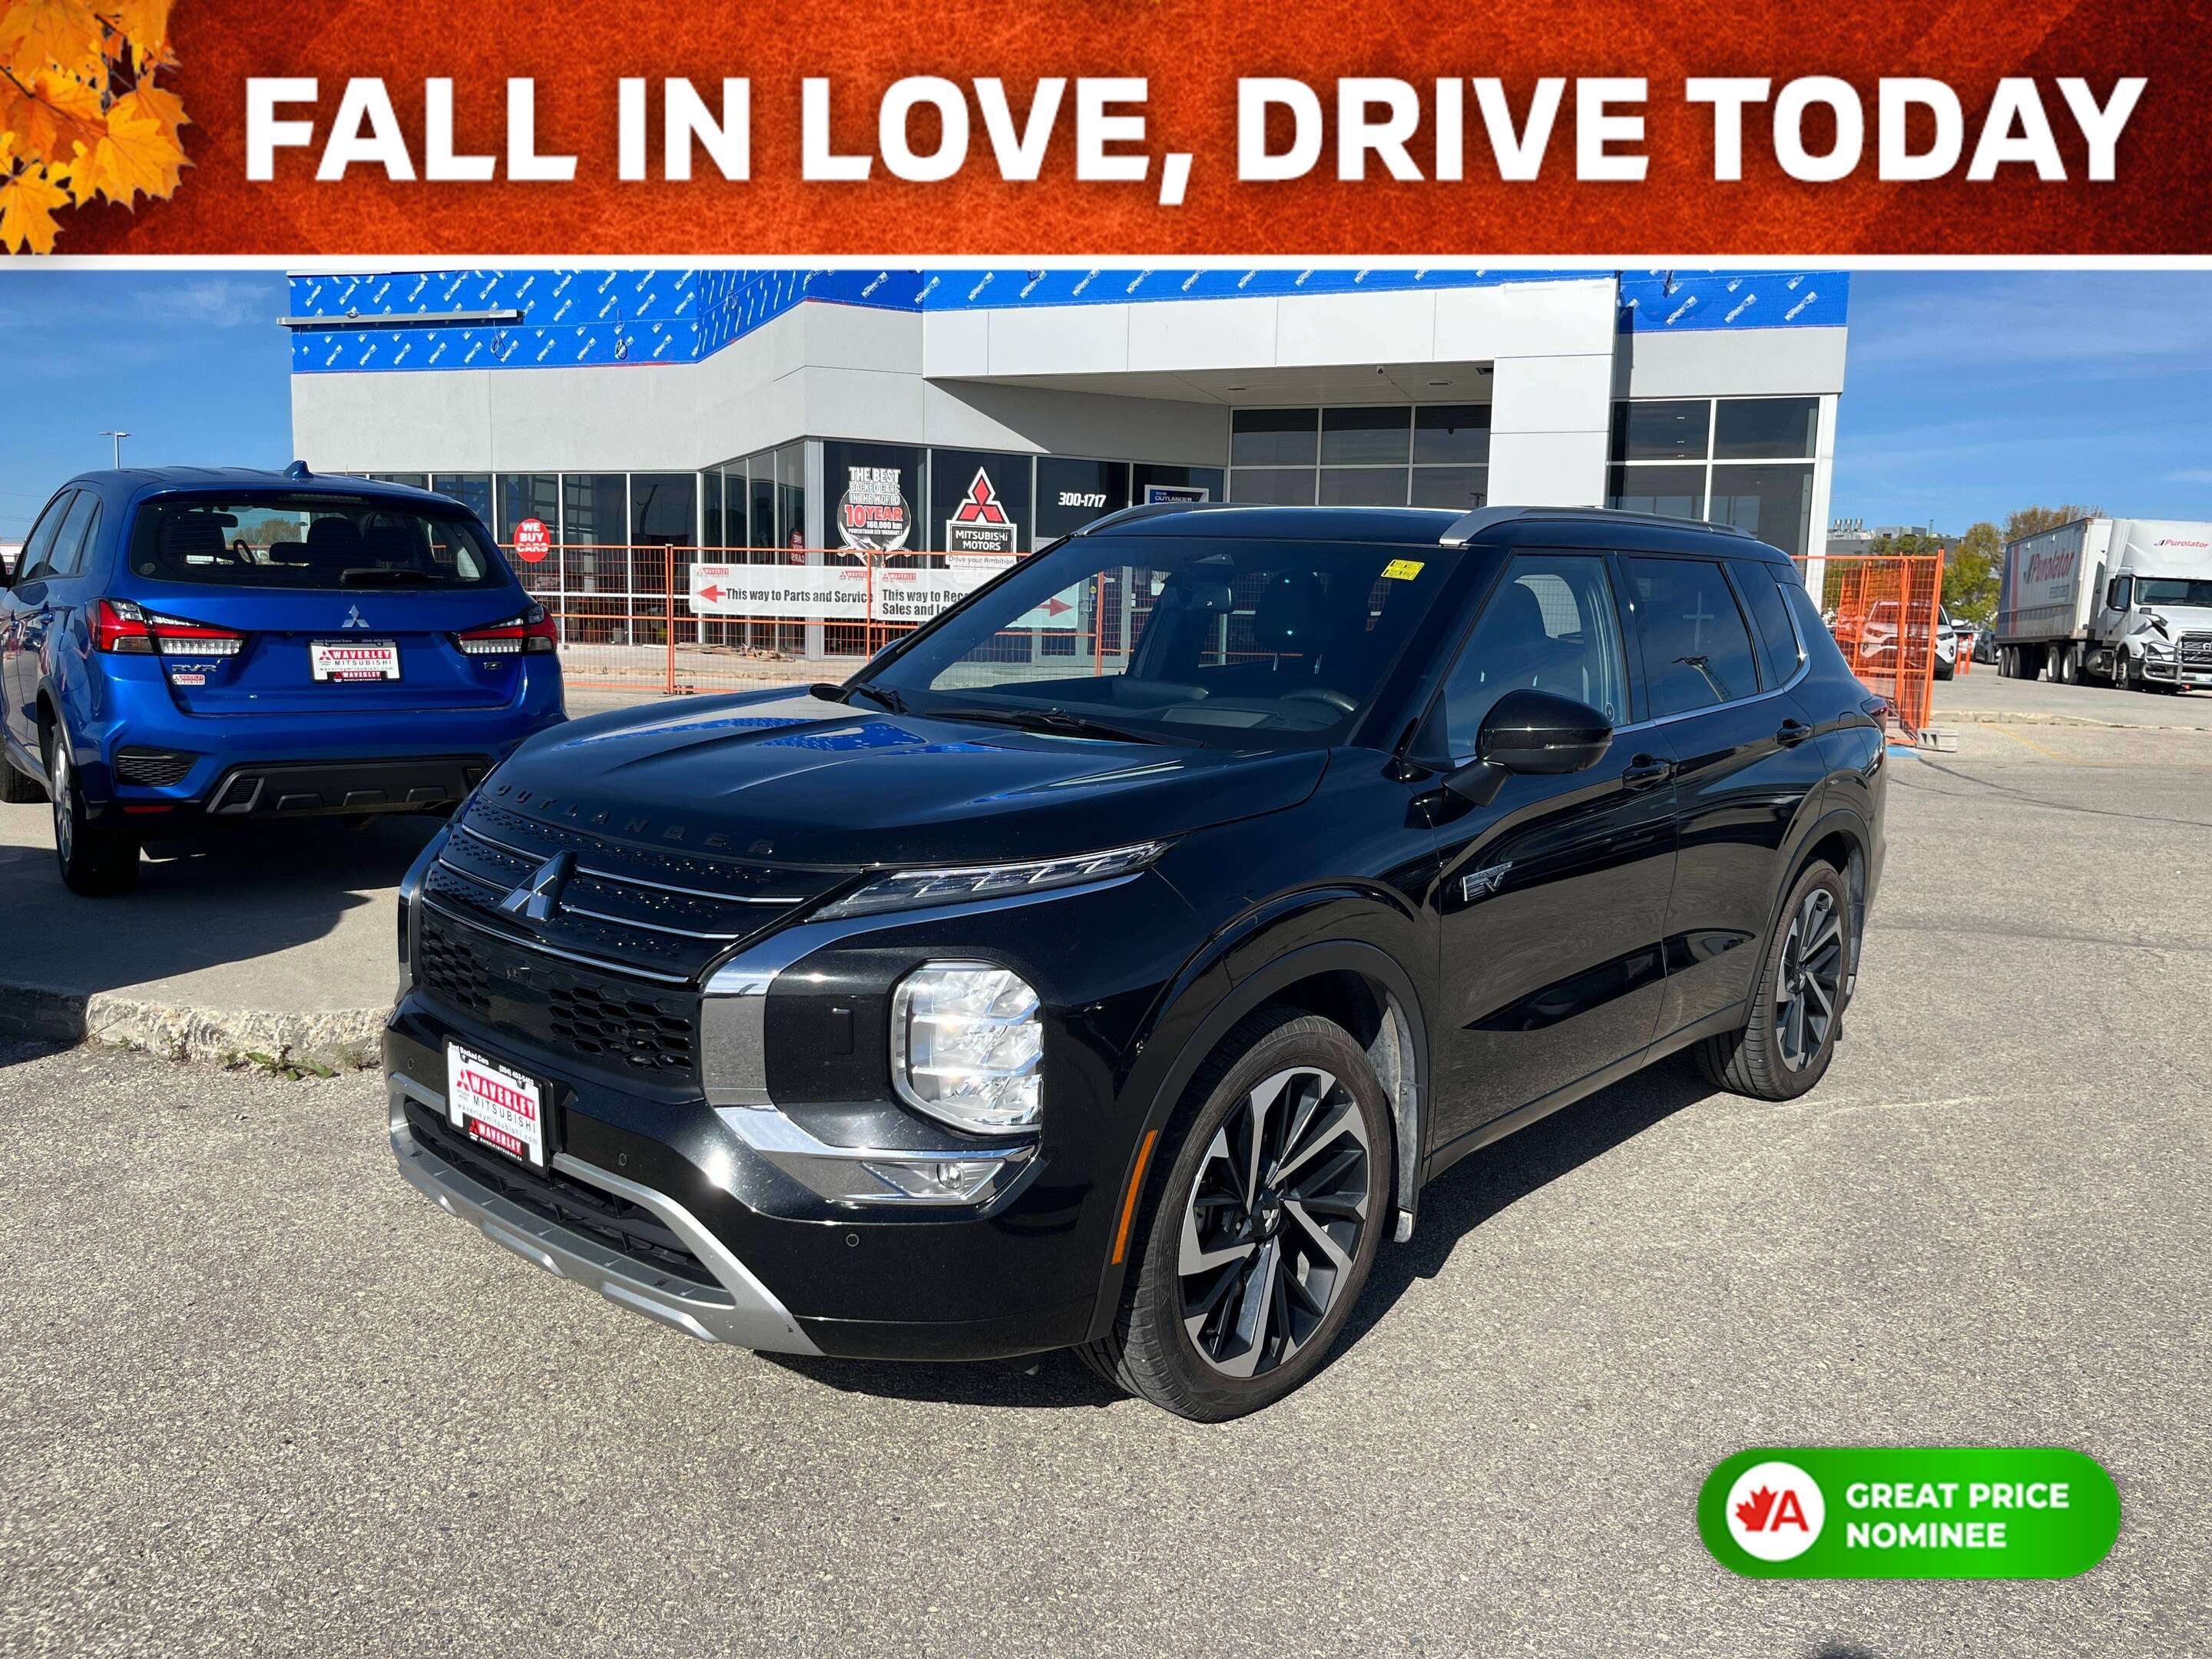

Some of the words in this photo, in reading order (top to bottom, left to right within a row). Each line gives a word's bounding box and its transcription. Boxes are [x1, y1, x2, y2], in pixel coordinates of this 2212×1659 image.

[848, 466, 870, 482] THE
[873, 468, 901, 483] BEST
[849, 492, 859, 504] IN
[859, 493, 873, 505] THE
[873, 494, 901, 505] WORLD
[1058, 492, 1107, 508] 300-1717
[845, 505, 866, 528] 10
[865, 505, 903, 522] YEAR
[522, 522, 541, 532] WE
[519, 533, 544, 542] BUY
[955, 530, 1008, 541] MITSUBISHI
[515, 542, 548, 552] CARS
[962, 541, 1002, 551] MOTORS
[2165, 539, 2209, 548] Purolator
[2032, 550, 2075, 583] Purolator
[727, 588, 747, 600] This
[750, 592, 769, 601] way
[771, 590, 781, 601] to
[783, 591, 810, 602] Parts
[813, 591, 832, 603] and
[882, 589, 905, 601] This
[906, 591, 928, 603] way
[930, 591, 941, 602] to
[882, 603, 912, 615] Sales
[914, 604, 934, 616] and
[333, 651, 392, 660] WAVERLEY
[171, 664, 217, 672] RVR
[470, 1074, 535, 1118] WAVERLEY
[473, 1095, 536, 1134] MITSUBISHI
[478, 1122, 522, 1152] WAVERLEY
